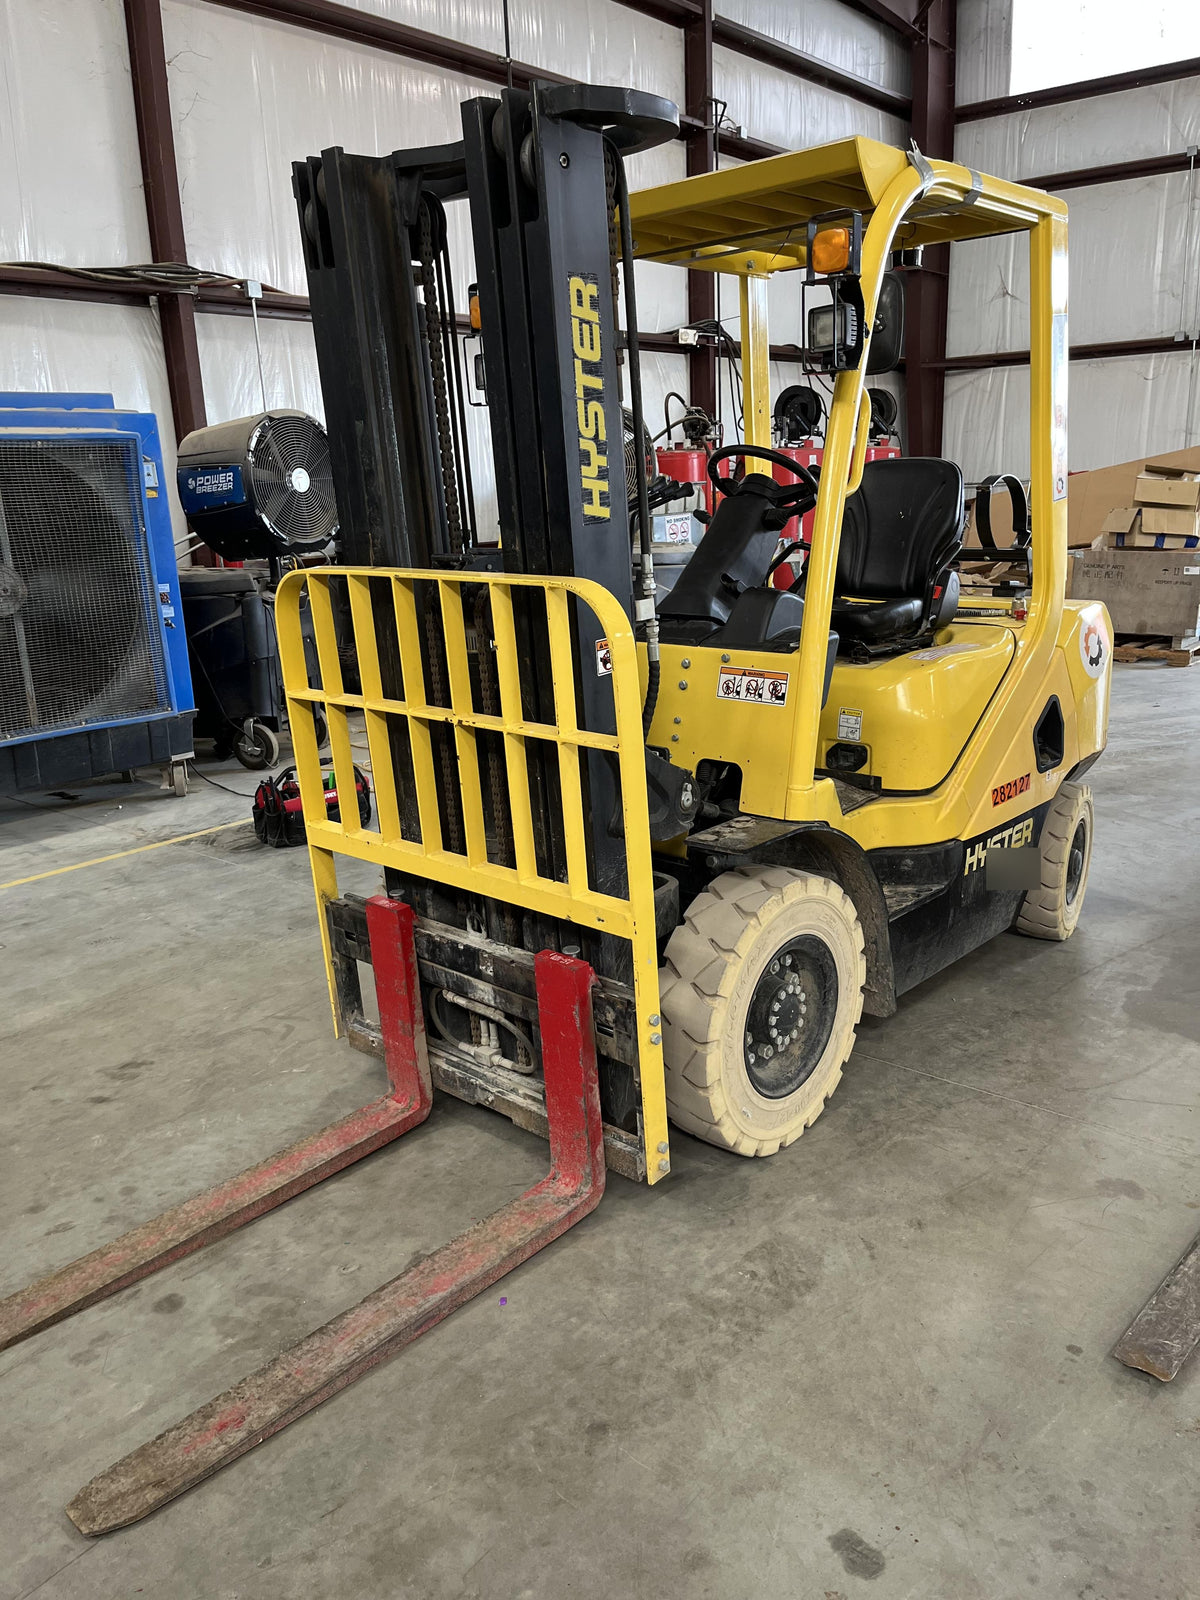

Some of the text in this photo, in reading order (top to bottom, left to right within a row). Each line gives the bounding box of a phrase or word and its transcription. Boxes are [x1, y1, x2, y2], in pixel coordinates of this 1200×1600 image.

[569, 276, 611, 518] HYSTER
[195, 482, 233, 494] BREEZER
[196, 472, 233, 486] POWER
[992, 773, 1031, 806] 282127
